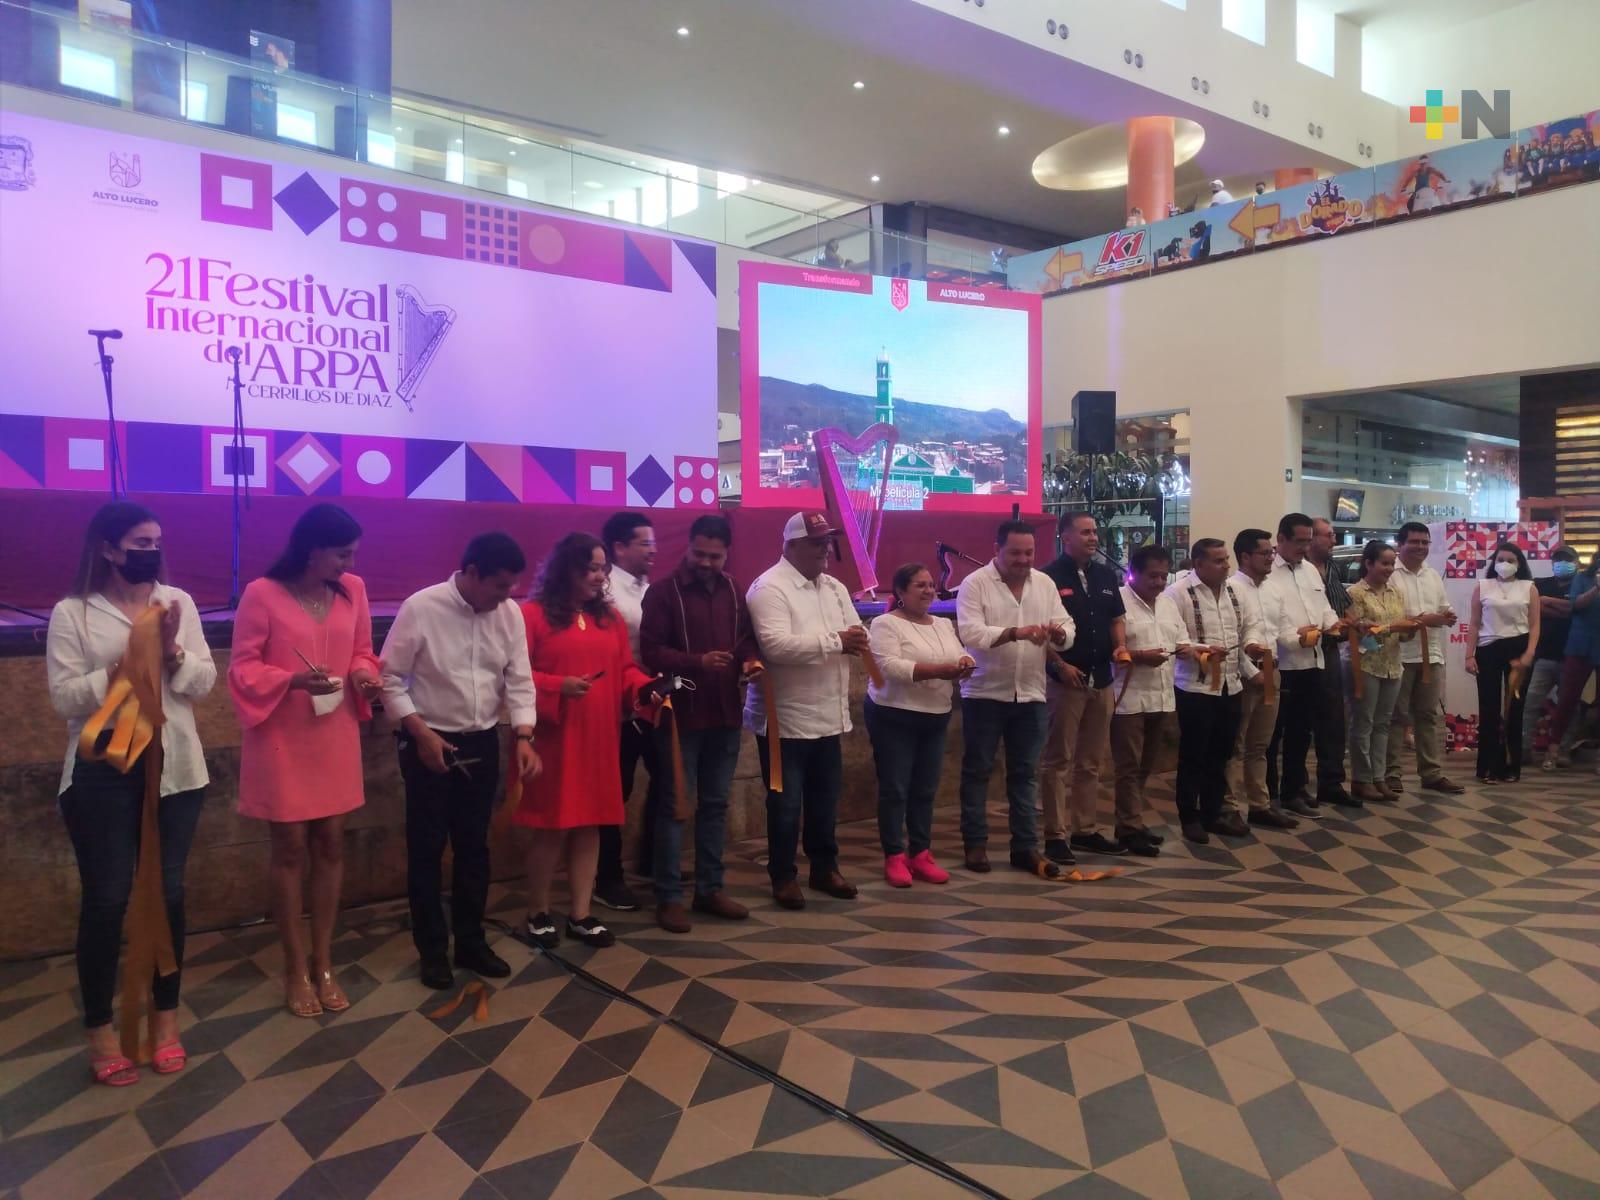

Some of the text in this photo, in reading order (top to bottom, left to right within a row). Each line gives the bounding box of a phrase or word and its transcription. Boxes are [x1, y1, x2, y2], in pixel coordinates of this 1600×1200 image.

[92, 191, 119, 201] ALTO
[120, 195, 158, 207] LUCERO
[1099, 231, 1146, 266] K1
[1094, 256, 1145, 276] SPEED
[939, 288, 985, 301] ALTO LUCERO
[146, 297, 390, 353] Internacional
[250, 343, 390, 393] ARPA
[247, 383, 393, 408] CERRILLOS DE DIAZ
[923, 487, 929, 499] 2
